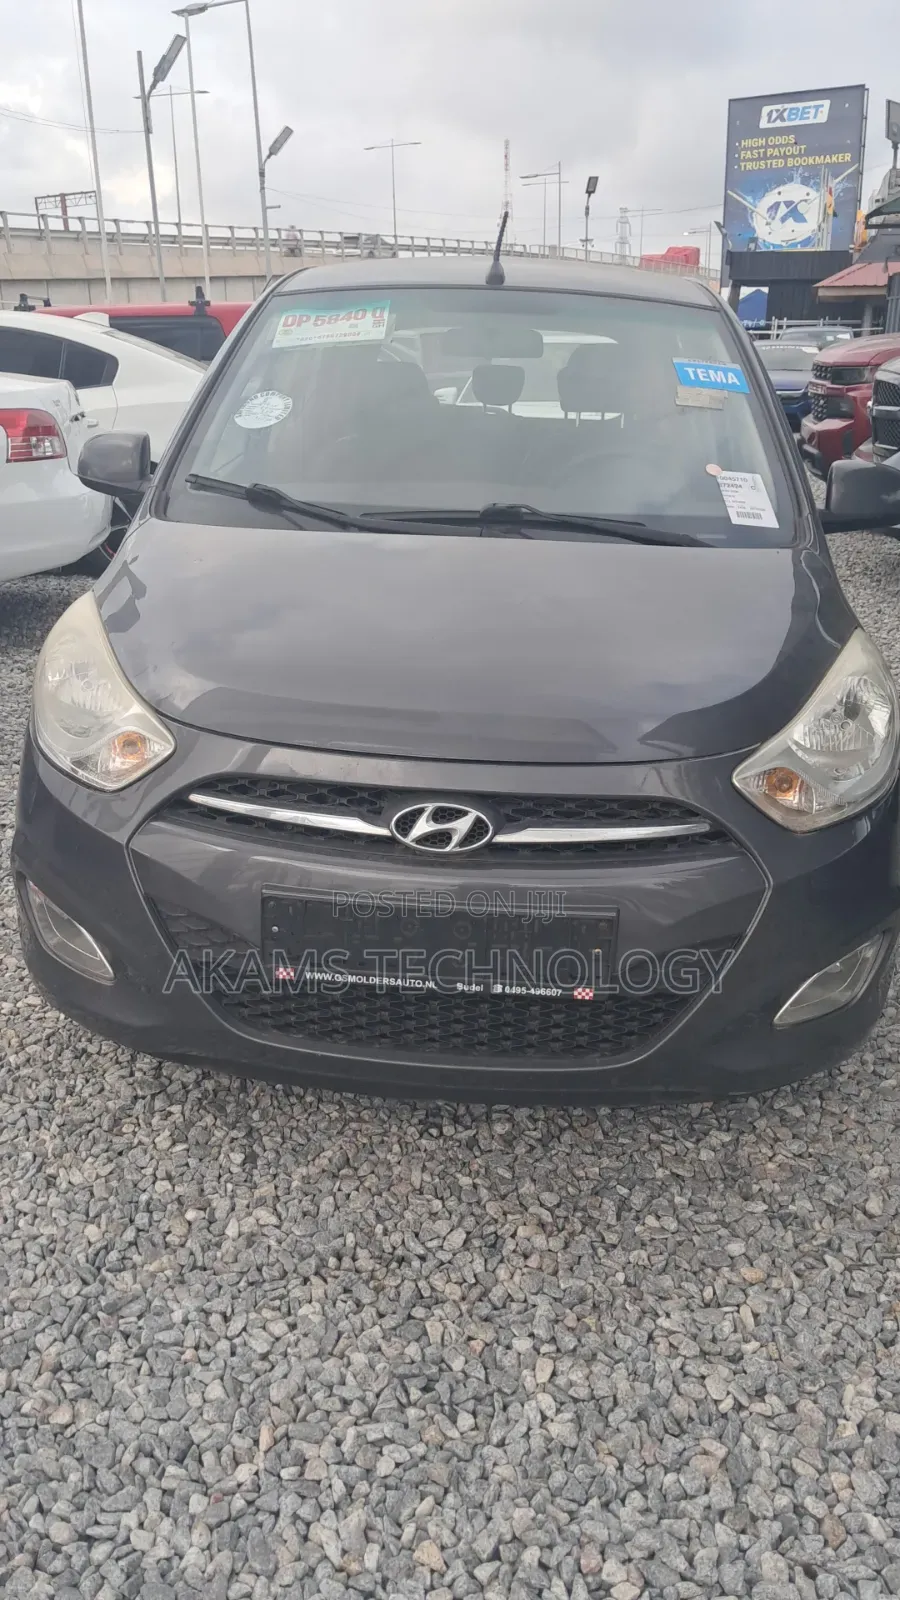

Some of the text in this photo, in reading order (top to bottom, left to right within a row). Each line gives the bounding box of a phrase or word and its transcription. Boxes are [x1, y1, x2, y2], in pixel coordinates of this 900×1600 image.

[766, 104, 824, 124] 1XBET
[741, 135, 795, 148] HIGH ODDS
[740, 145, 806, 160] FAST PAYOUT
[740, 153, 851, 171] TRUSTED BOOKMAKER
[684, 367, 741, 386] TEMA
[305, 971, 438, 989] WWW.GSMOLDERSAUTO.NL
[456, 982, 483, 992] Budel
